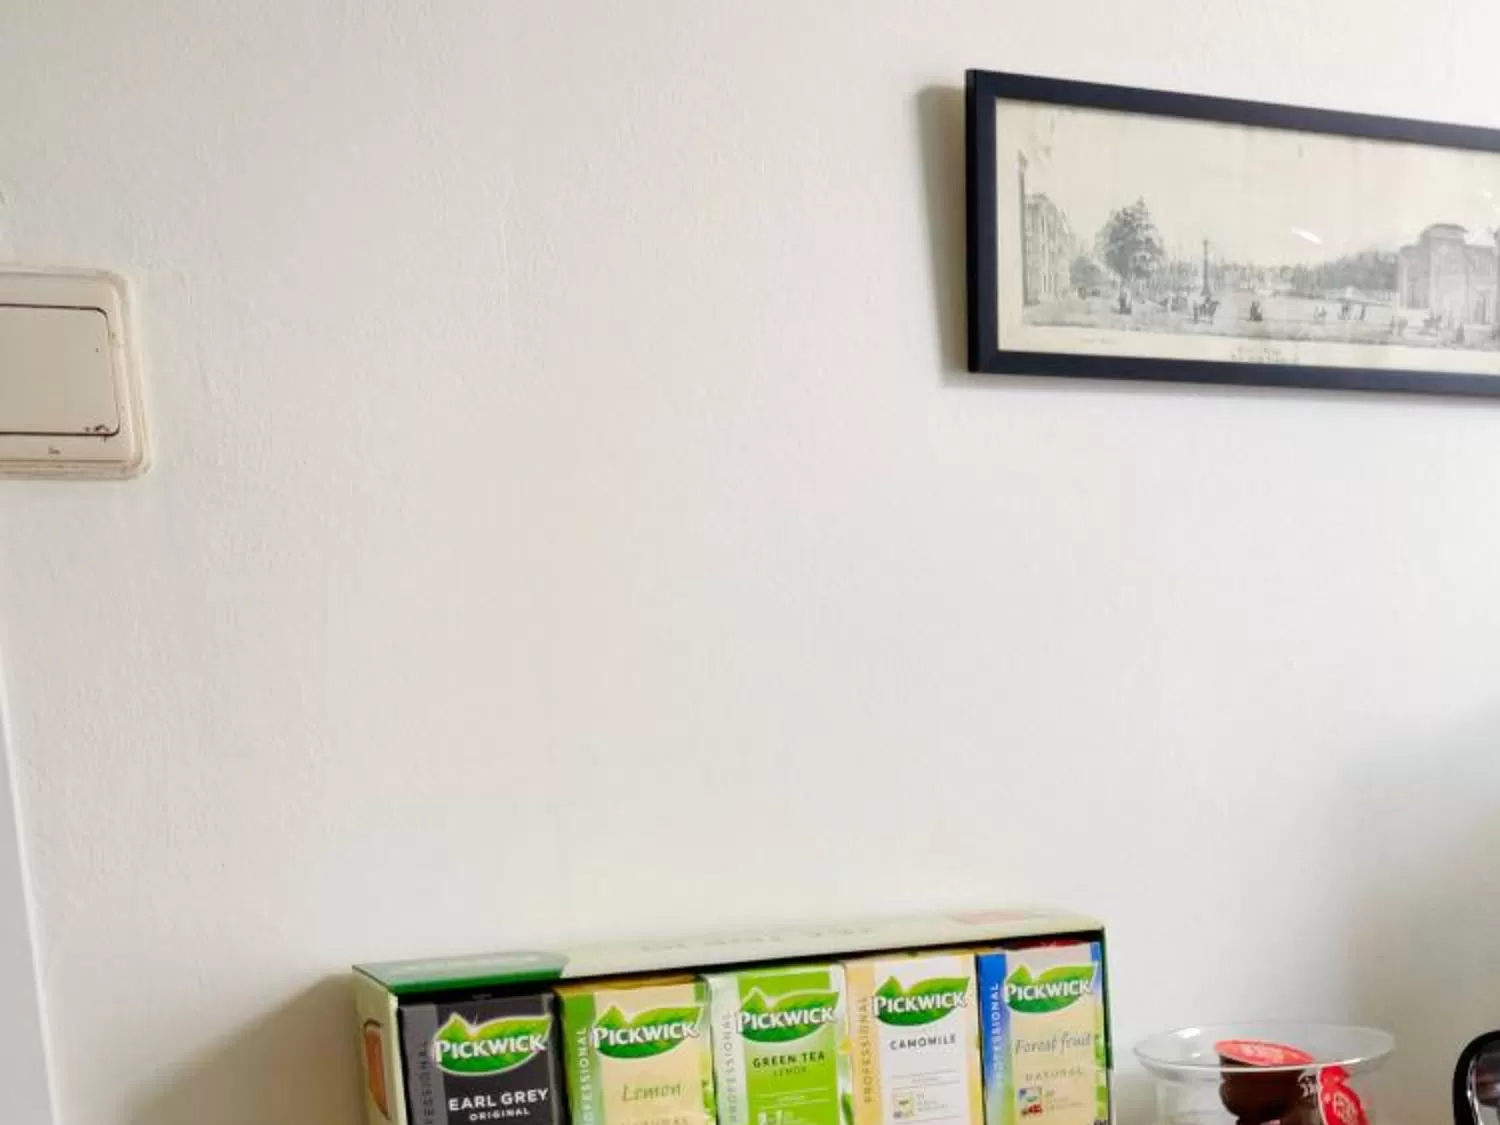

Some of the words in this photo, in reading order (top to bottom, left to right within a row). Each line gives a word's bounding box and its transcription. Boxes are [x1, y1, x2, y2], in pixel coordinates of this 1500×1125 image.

[873, 991, 966, 1017] PICKWICK
[1005, 979, 1093, 1004] PICKWICK
[737, 1007, 835, 1033] PICKWICK
[591, 1022, 699, 1049] PICKWICK
[889, 1034, 957, 1050] CAMOMILE
[1015, 1036, 1058, 1055] Forest
[1059, 1030, 1091, 1053] fruit
[432, 1034, 547, 1063] PICKWICK
[752, 1054, 797, 1068] GREEN
[802, 1051, 825, 1063] TEA
[448, 1095, 497, 1112] EARL
[501, 1088, 549, 1106] GREY
[621, 1082, 682, 1102] Lemon
[469, 1107, 530, 1121] ORIGINAL
